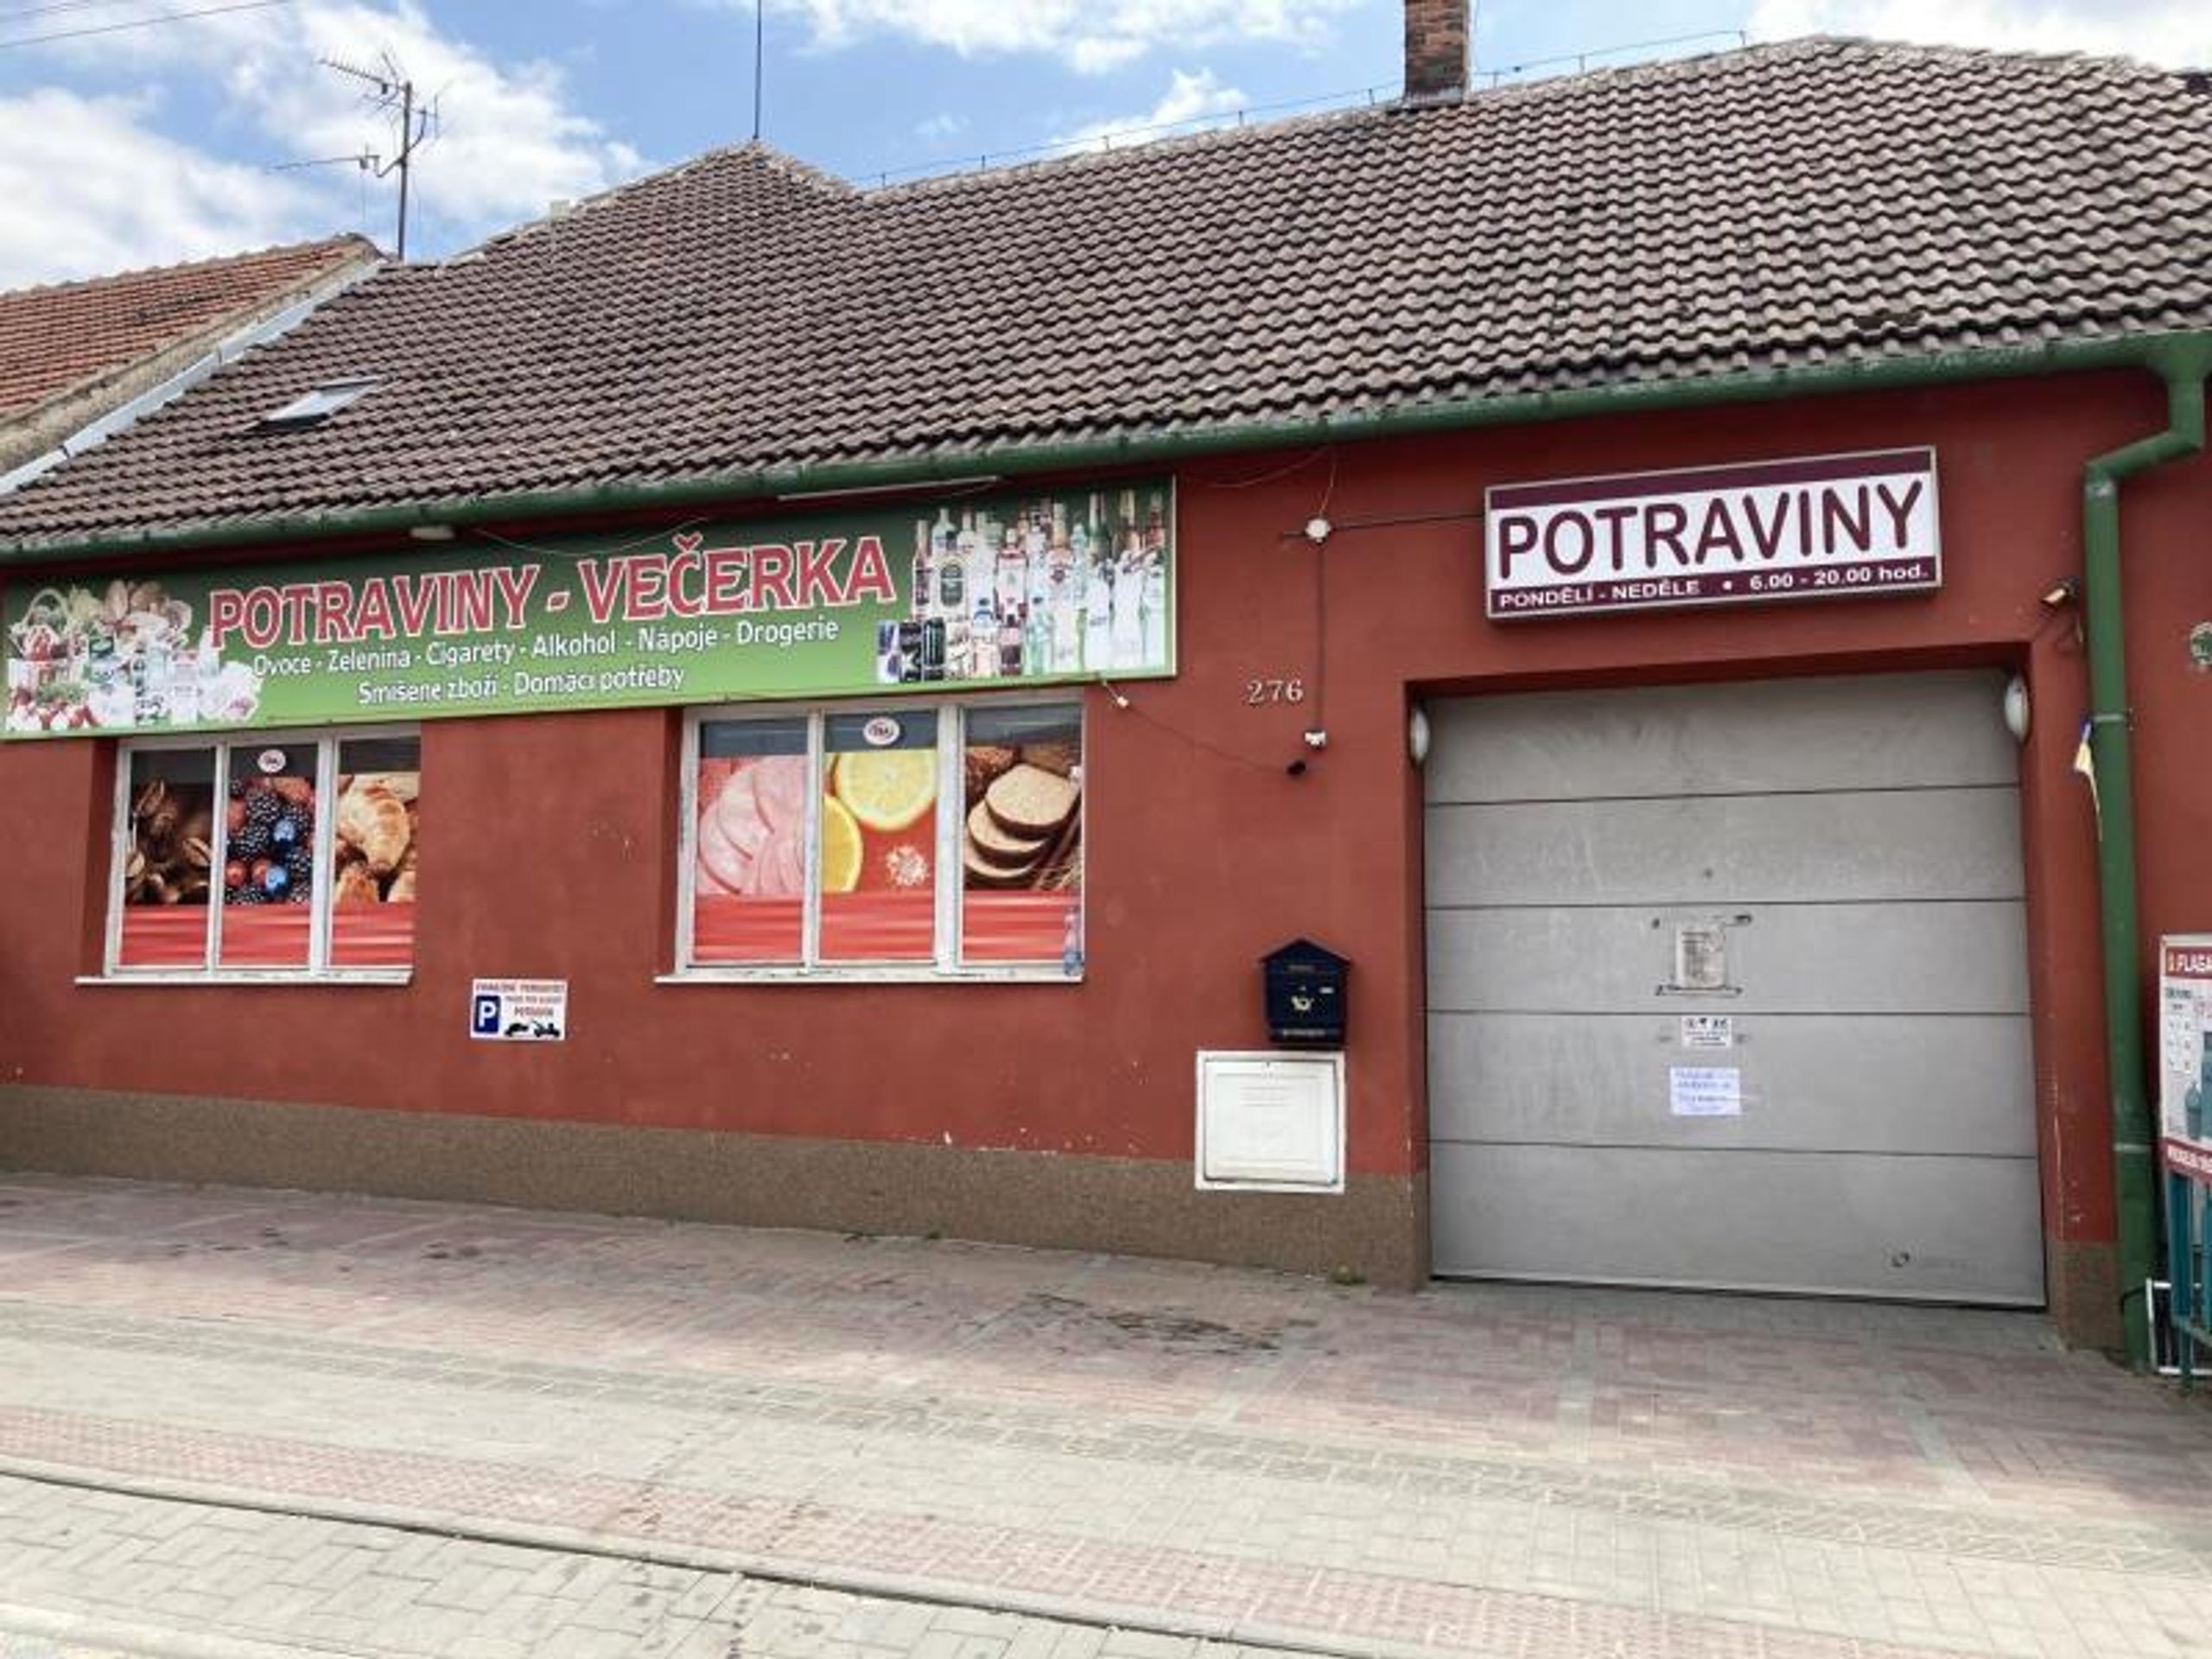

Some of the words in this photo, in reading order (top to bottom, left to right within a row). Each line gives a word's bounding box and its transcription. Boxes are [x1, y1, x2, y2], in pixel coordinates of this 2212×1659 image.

[1498, 480, 1923, 580] POTRAVINY
[210, 564, 540, 652] POTRAVINY
[576, 532, 897, 624] VEČERKA
[1500, 584, 1593, 607] PONDĚLÍ
[1612, 580, 1700, 600] NEDĚLE
[1750, 573, 1793, 590] 6.00
[1814, 567, 1871, 585] 20.00
[1878, 564, 1929, 581] hod.
[253, 654, 311, 676] Ovoce
[327, 647, 411, 671] Zelenina
[427, 639, 516, 668] Cigarety
[531, 629, 616, 658] Alkohol
[638, 623, 717, 653] Nápoje
[737, 614, 839, 647] Drogerie
[600, 663, 685, 691] potřeby
[1247, 679, 1303, 702] 276
